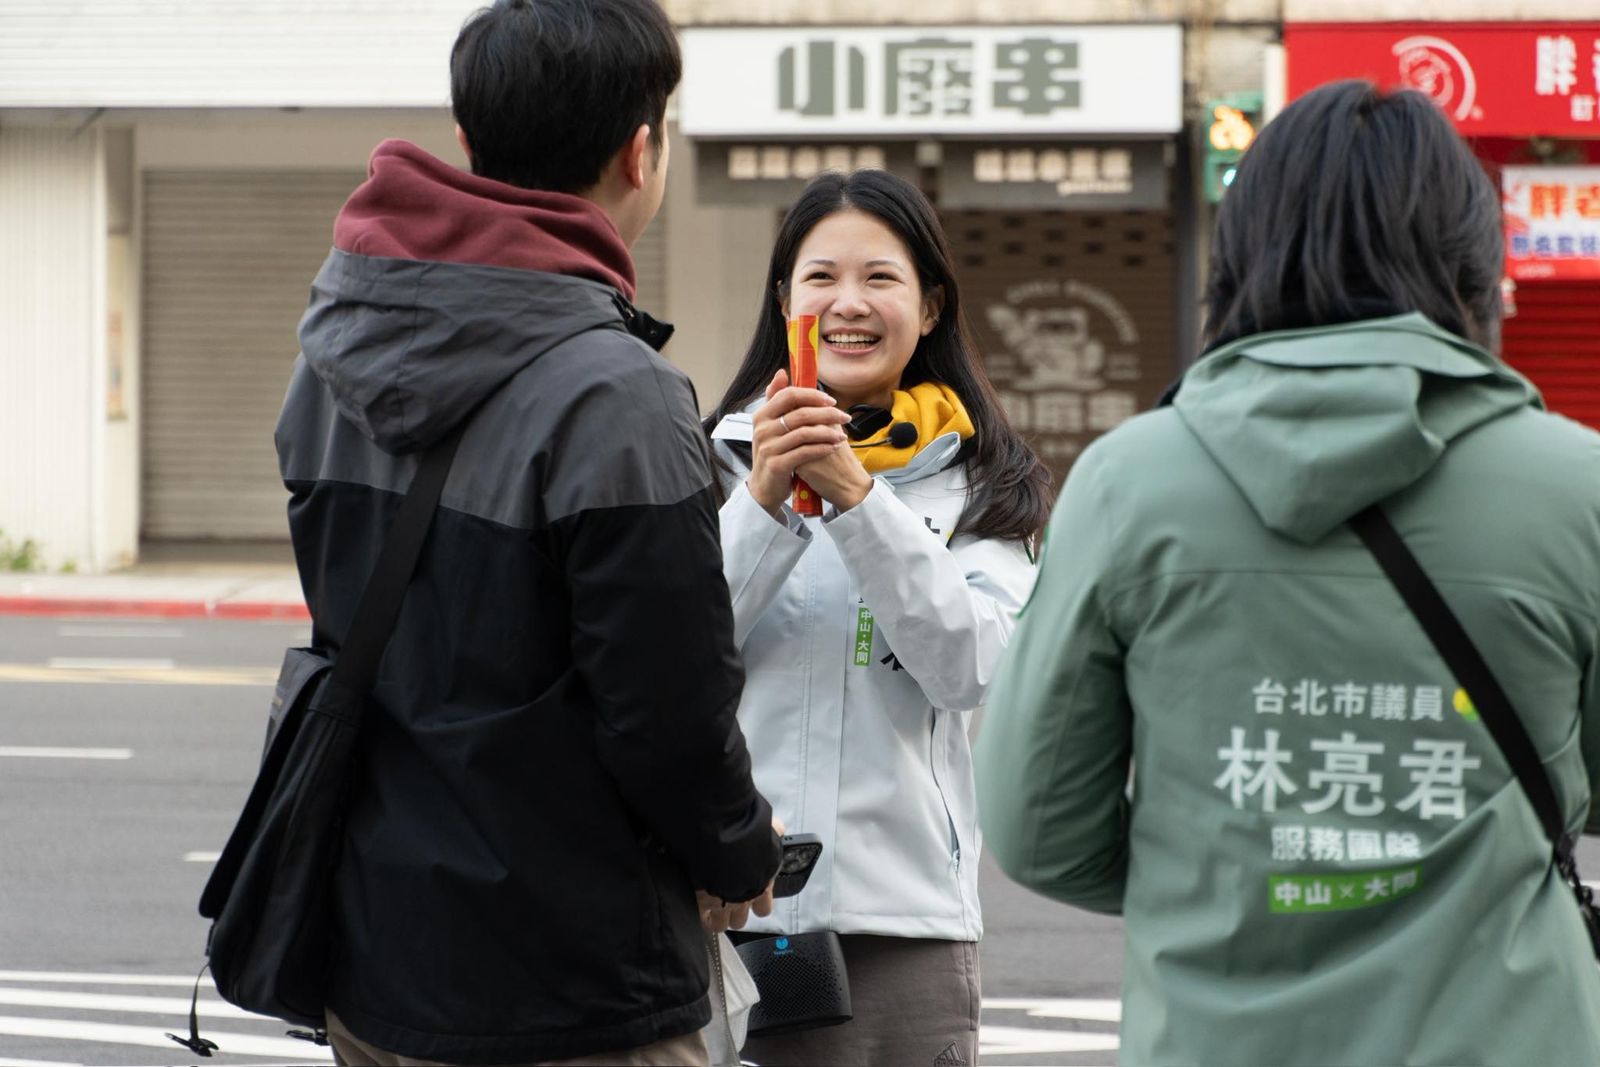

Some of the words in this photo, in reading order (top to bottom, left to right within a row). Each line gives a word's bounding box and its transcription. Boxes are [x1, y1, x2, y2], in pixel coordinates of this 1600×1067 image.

[778, 37, 1082, 117] 小廢串
[1252, 677, 1444, 722] 台北市議員
[1213, 726, 1482, 820] 林亮君
